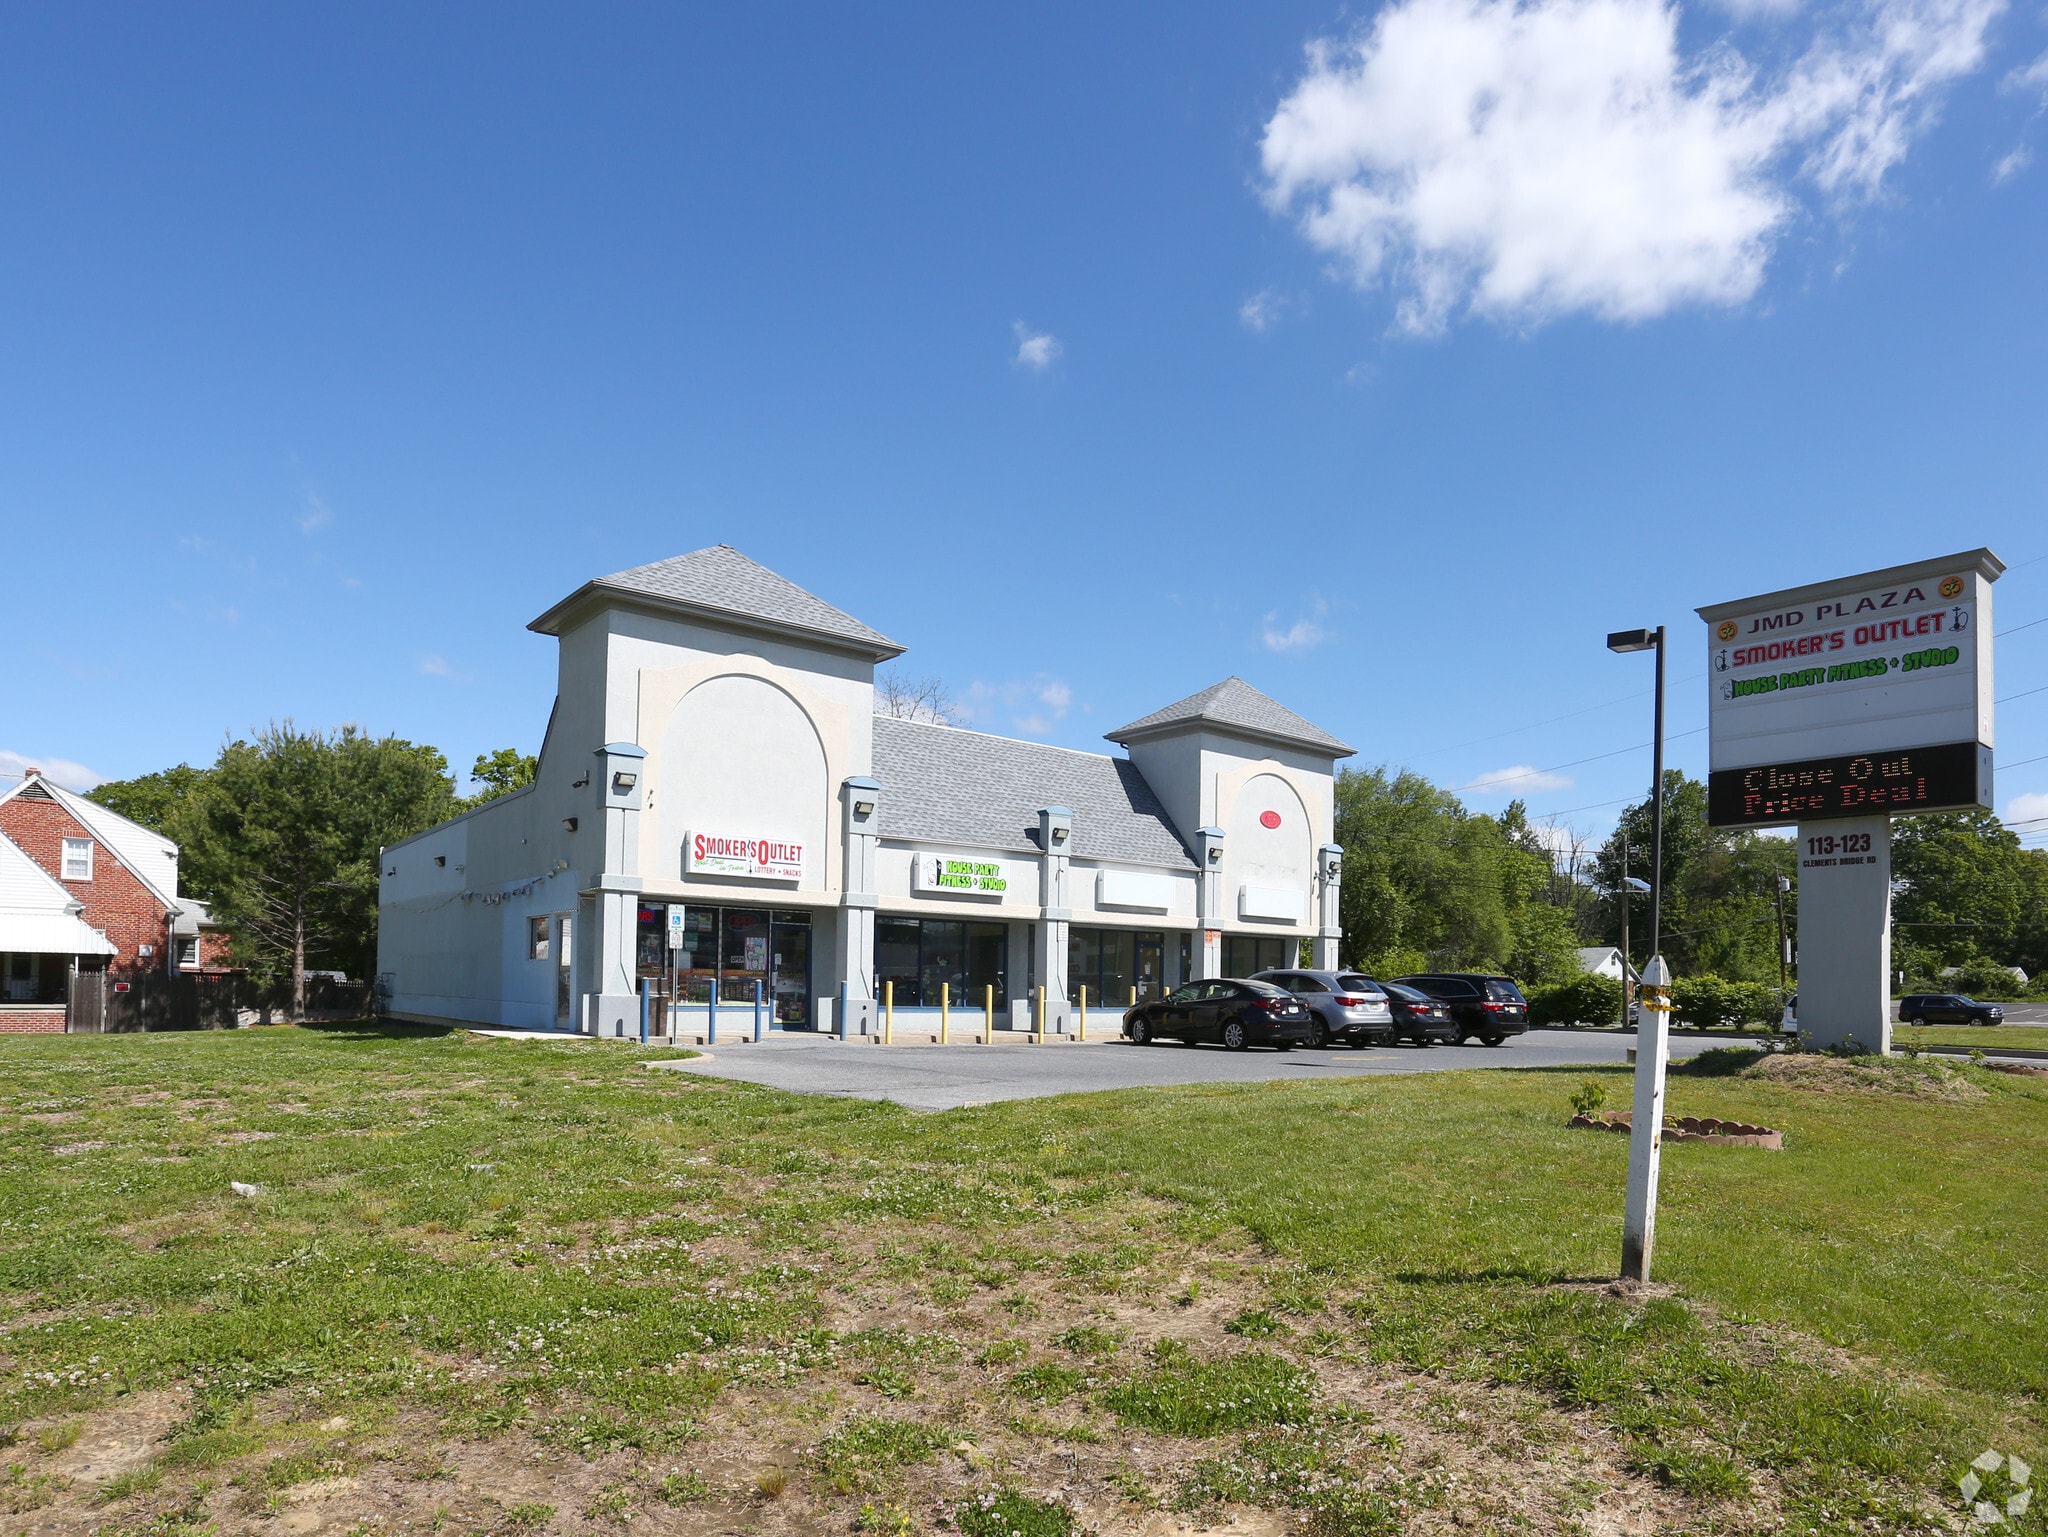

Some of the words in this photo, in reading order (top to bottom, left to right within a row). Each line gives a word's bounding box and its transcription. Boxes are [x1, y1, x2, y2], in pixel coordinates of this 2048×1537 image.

[1747, 610, 1804, 634] JMD
[1816, 587, 1926, 621] PLAZA
[1733, 631, 1844, 667] SMOKER'S
[1853, 611, 1947, 646] OUTLET
[1733, 674, 1778, 698] HOUSE
[1779, 667, 1826, 690] PARTY
[1827, 657, 1888, 682] FITNESS
[1901, 645, 1960, 672] STUDIO
[1744, 768, 1834, 791] Close
[1849, 757, 1913, 780] Out
[1840, 777, 1927, 807] Deal
[695, 834, 756, 860] SMOKER'S
[758, 840, 802, 865] OUTLET
[1807, 833, 1871, 855] 113-123
[754, 866, 776, 875] LOTTERY
[782, 868, 802, 877] SNACKS
[946, 861, 972, 874] HOUSE
[974, 863, 999, 876] PARTY
[1803, 858, 1837, 867] CLEMENTS
[1839, 857, 1864, 865] BRIDGE
[1866, 856, 1877, 864] RD
[939, 874, 972, 889] FITNESS
[979, 877, 1006, 891] STUDIO
